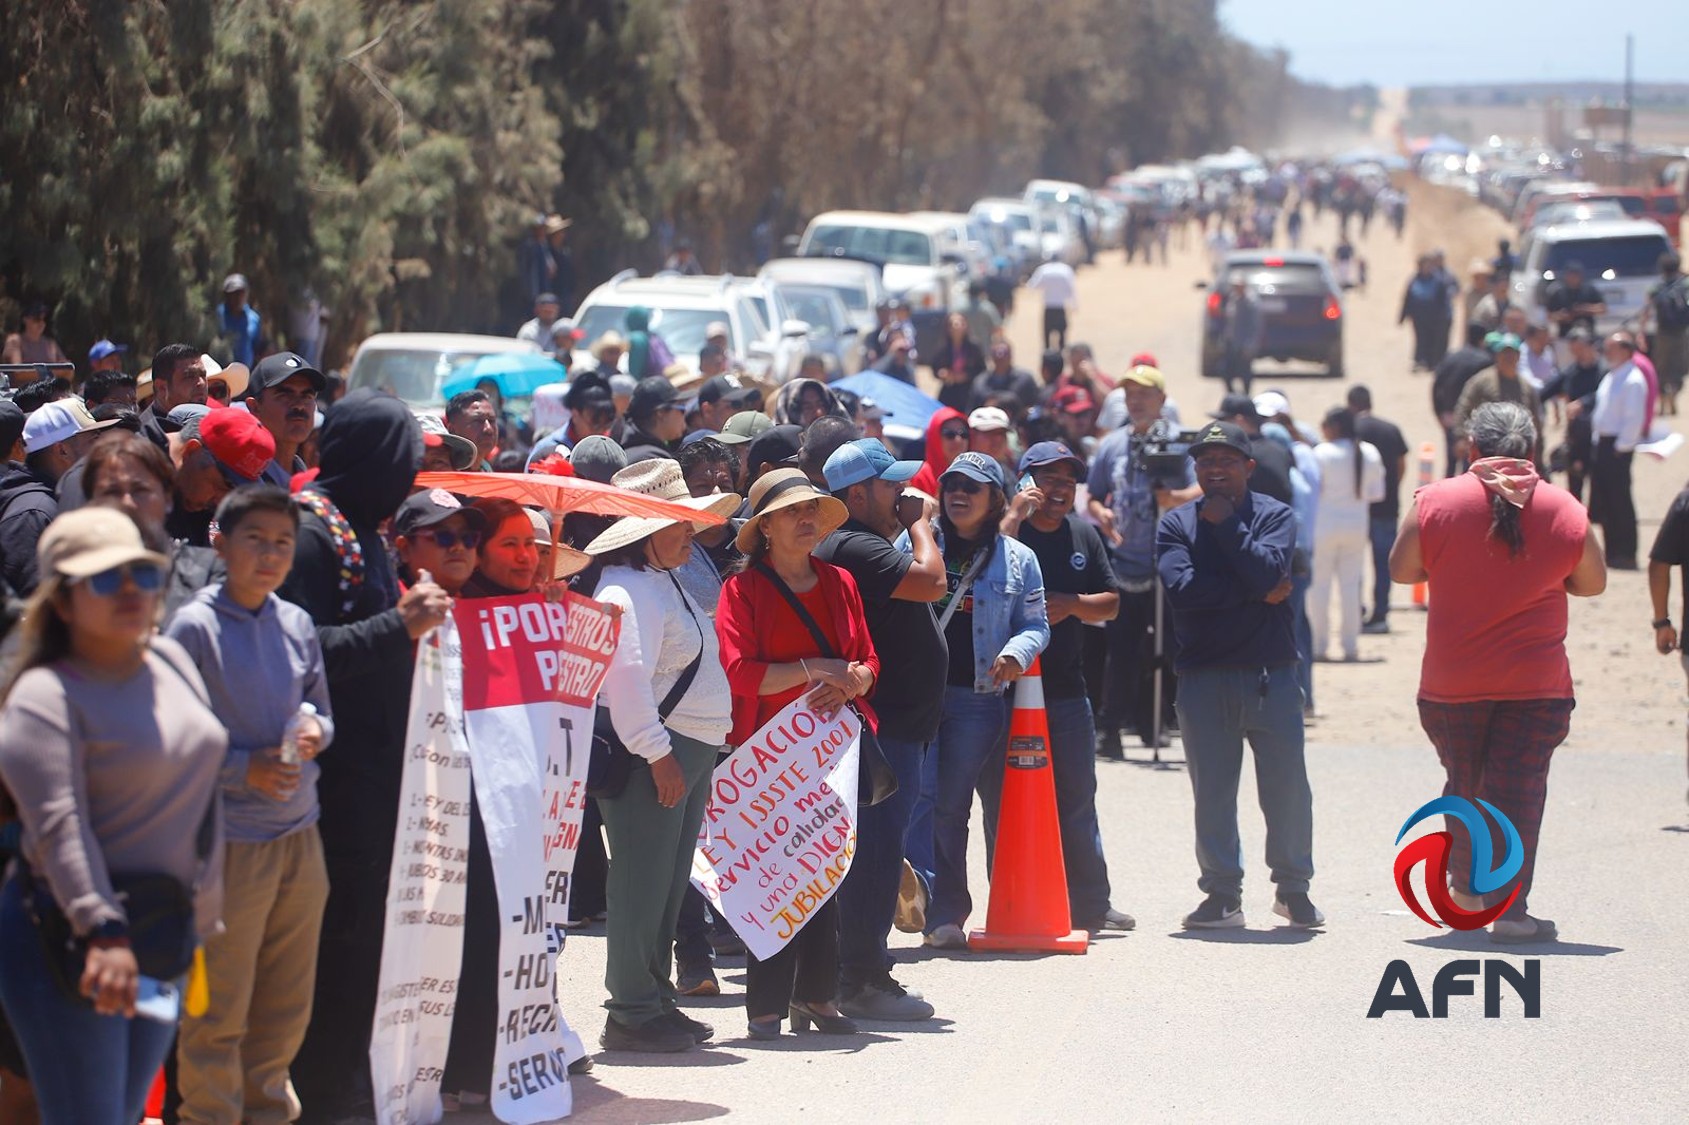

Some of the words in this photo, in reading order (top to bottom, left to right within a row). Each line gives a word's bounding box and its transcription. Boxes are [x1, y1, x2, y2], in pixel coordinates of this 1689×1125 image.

[739, 759, 810, 830] ISSSTE
[700, 815, 789, 901] Servicio
[759, 862, 782, 888] de
[741, 911, 765, 931] y
[760, 872, 799, 912] una
